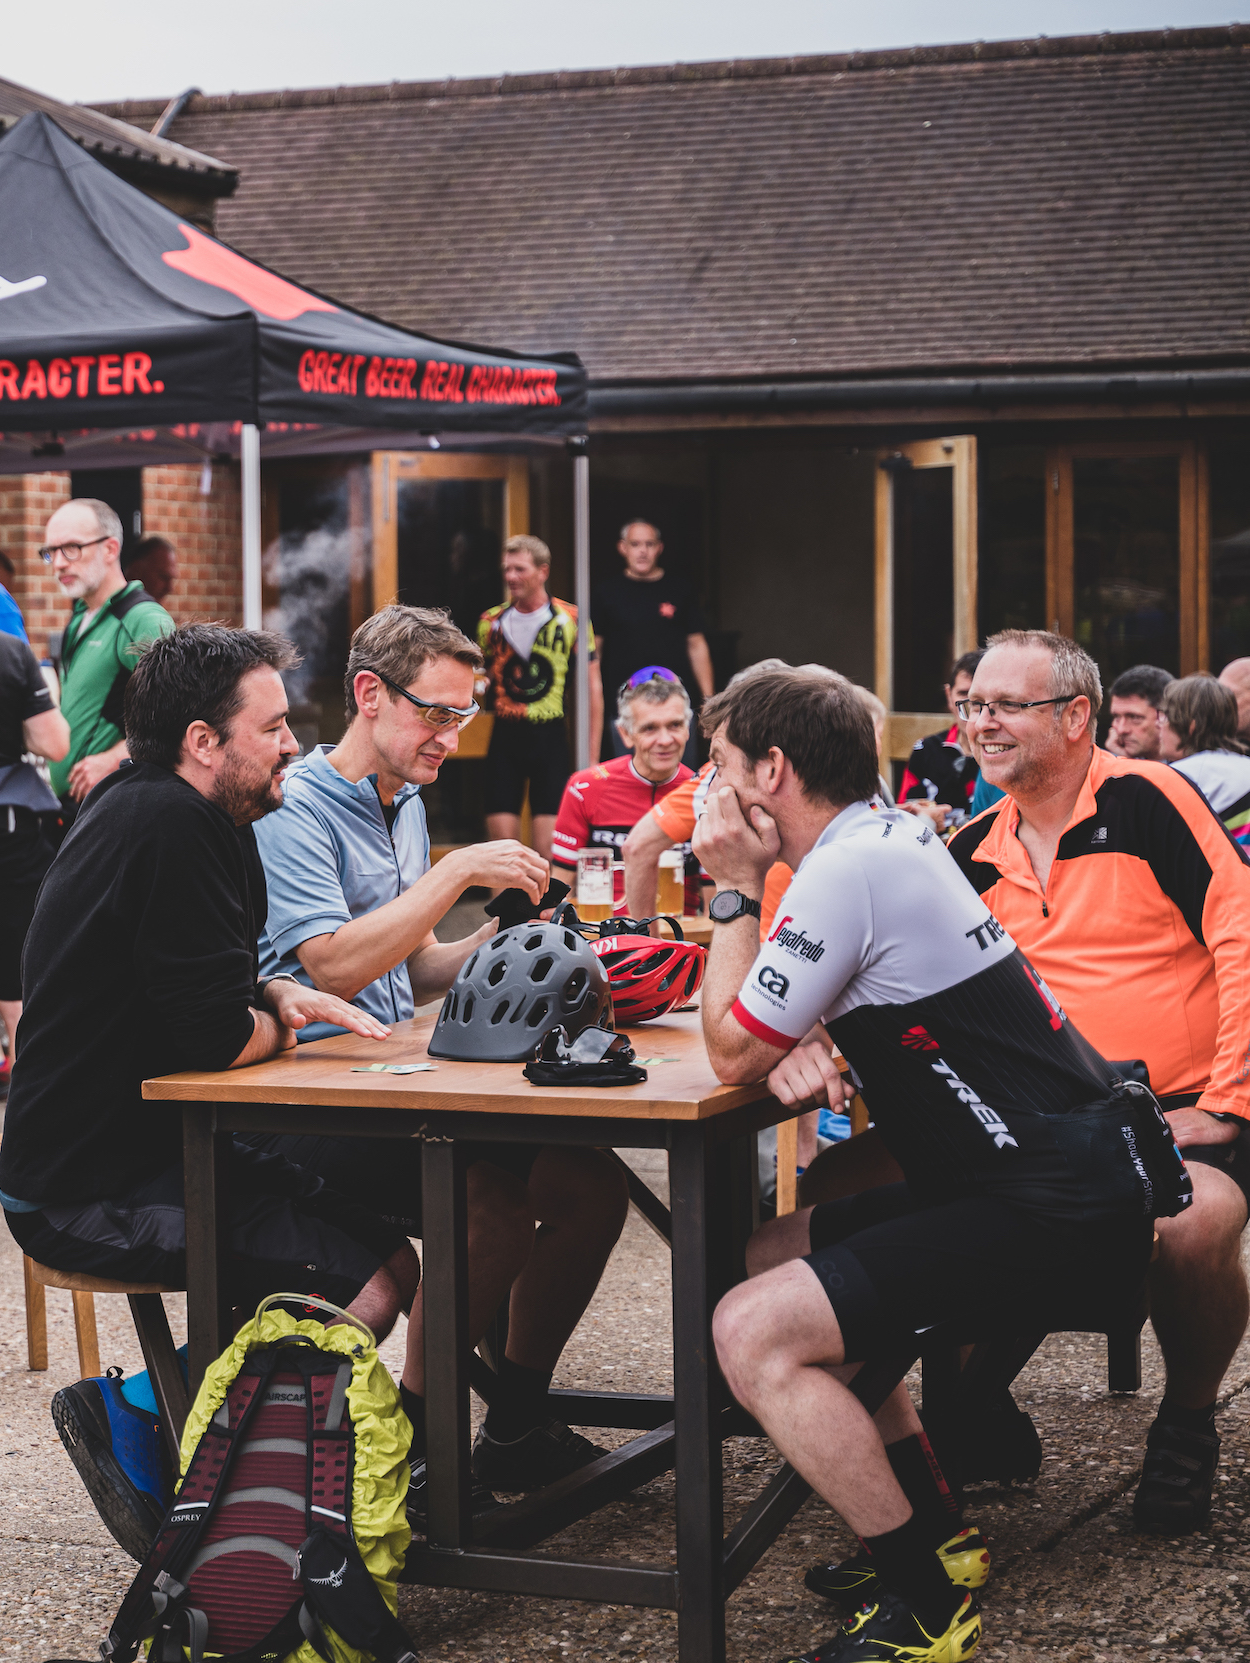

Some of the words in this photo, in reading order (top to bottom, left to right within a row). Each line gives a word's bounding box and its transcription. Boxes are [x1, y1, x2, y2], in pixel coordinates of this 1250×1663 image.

[298, 349, 366, 396] GREAT
[364, 355, 418, 399] BEER.
[419, 359, 465, 404] REAL
[881, 821, 893, 839] TREK
[591, 937, 618, 956] KA
[768, 915, 825, 963] Segafredo
[785, 947, 808, 964] ZANETTI
[751, 982, 787, 1011] technologies
[931, 1057, 1019, 1149] TREK
[265, 1392, 306, 1402] AIRSCAP
[170, 1513, 202, 1523] OSPREY
